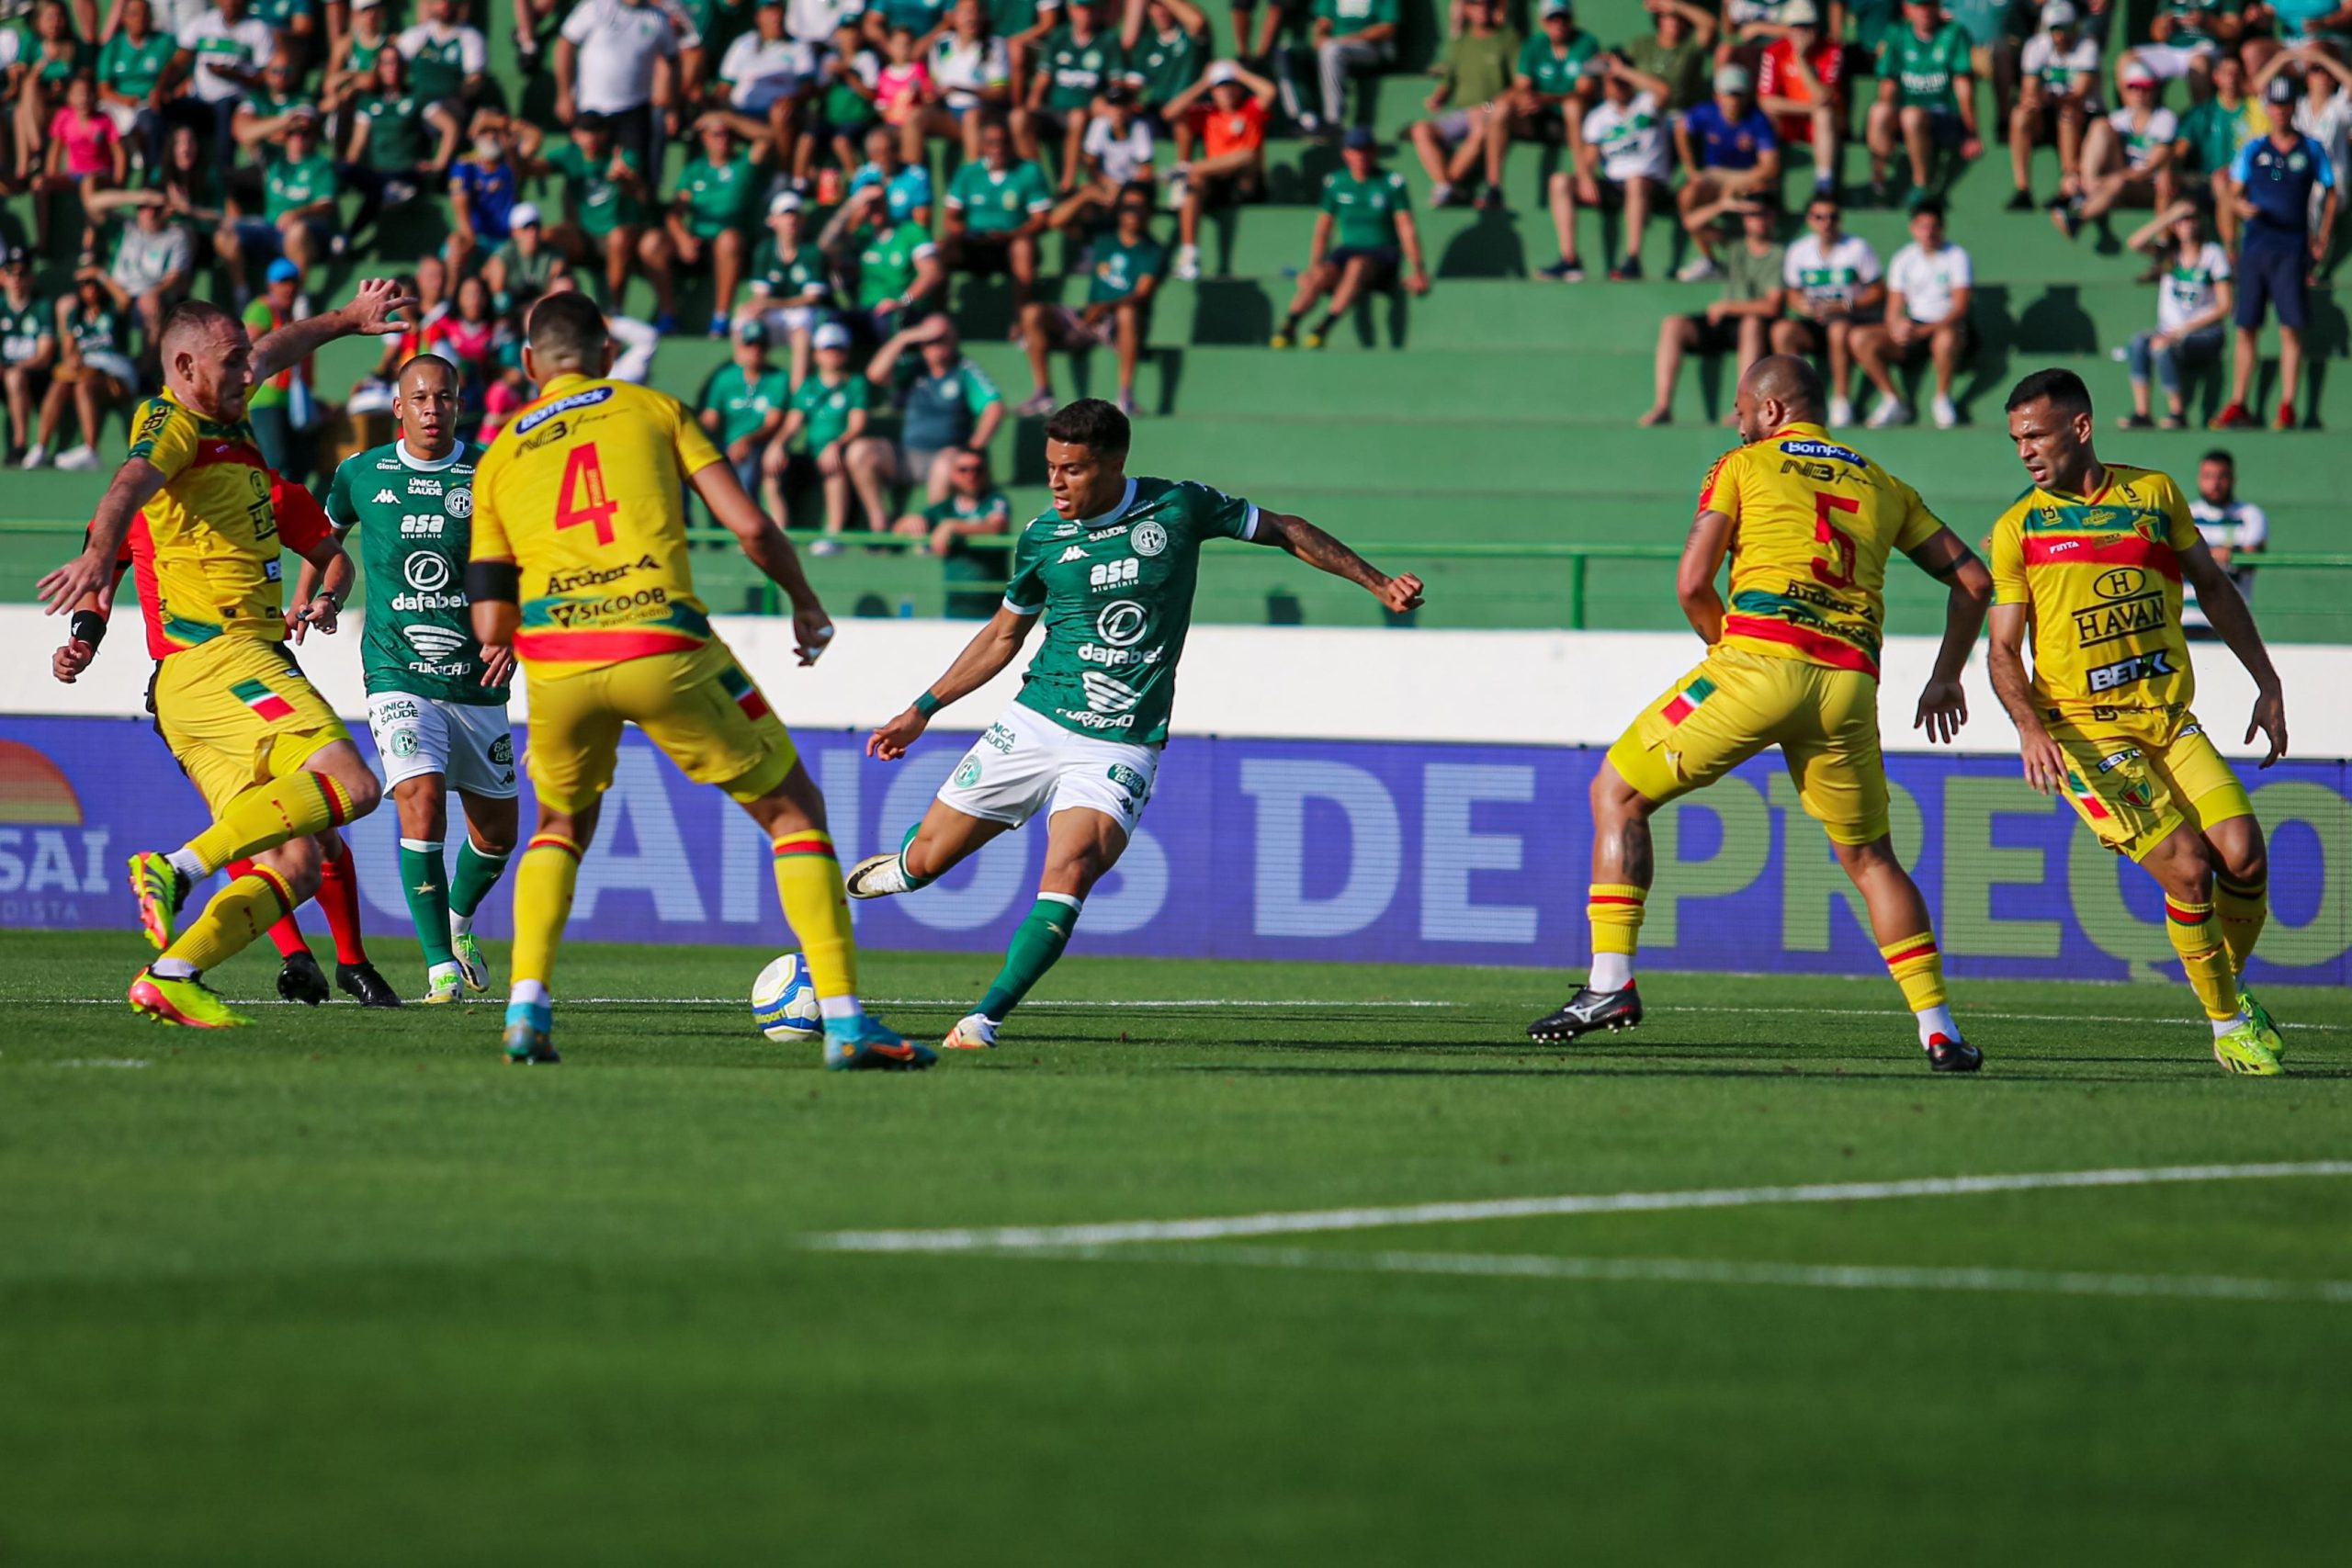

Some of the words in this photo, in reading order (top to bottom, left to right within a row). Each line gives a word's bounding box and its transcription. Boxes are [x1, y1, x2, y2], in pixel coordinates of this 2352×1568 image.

[519, 389, 607, 431] Bompack
[1788, 442, 1860, 462] Bomp
[556, 441, 618, 547] 4
[401, 514, 445, 534] asa
[1810, 491, 1860, 589] 5
[546, 563, 630, 597] Archer
[1090, 558, 1139, 586] asa
[580, 587, 667, 621] SICOOB
[2075, 596, 2165, 642] HAVAN
[1240, 759, 1538, 943] DE
[1634, 770, 2352, 985] PREÇO
